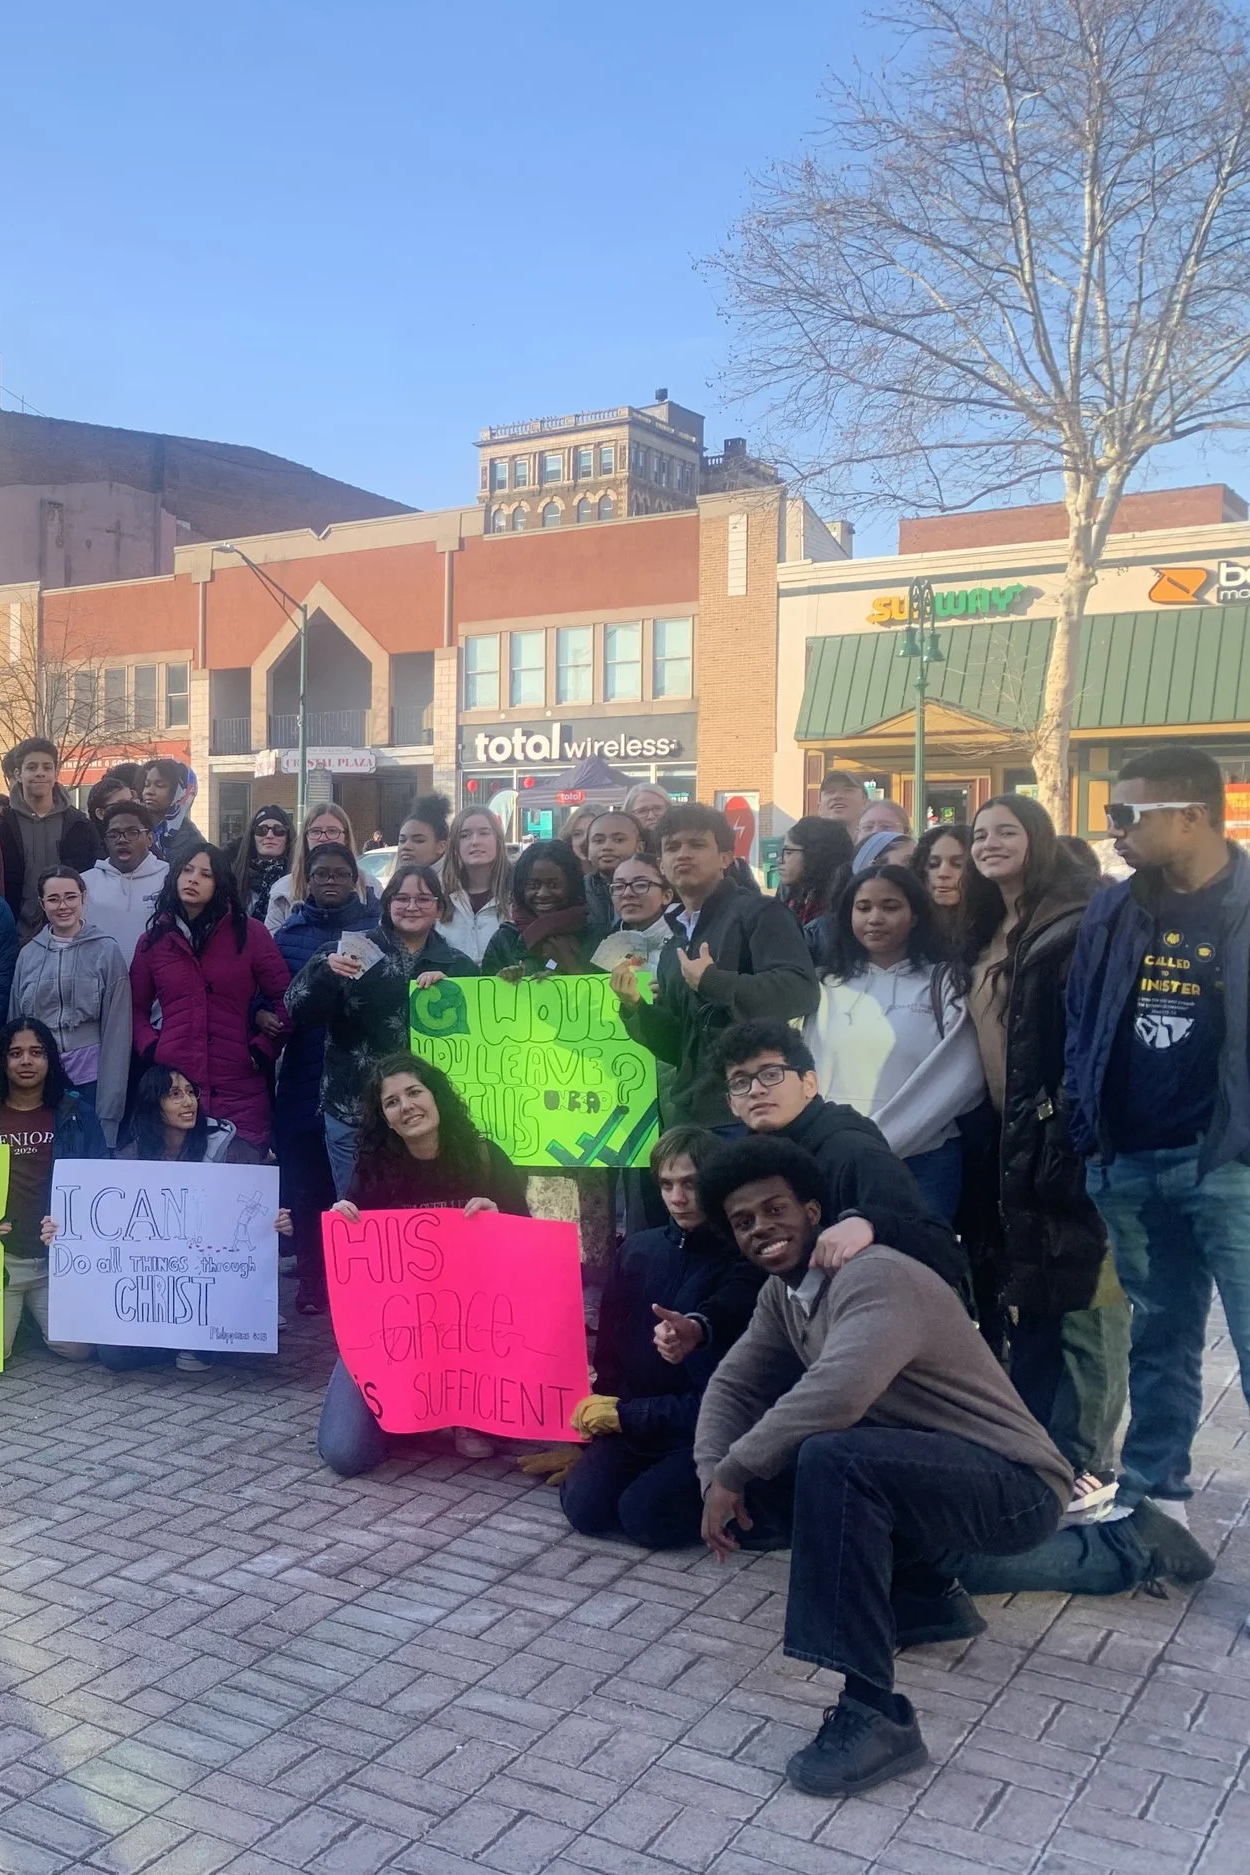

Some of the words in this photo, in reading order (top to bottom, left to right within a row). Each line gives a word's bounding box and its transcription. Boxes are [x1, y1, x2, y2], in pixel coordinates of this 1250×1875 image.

[475, 722, 561, 762] total
[564, 733, 671, 758] wireless
[286, 758, 334, 768] CSTAL
[337, 757, 374, 768] PLAZA
[560, 791, 582, 801] total
[1144, 955, 1190, 969] CALLED
[1140, 978, 1201, 996] INISTER
[476, 1044, 603, 1086] LEAVE
[14, 1147, 38, 1156] 2026
[55, 1185, 82, 1241] I
[89, 1187, 189, 1241] CAN
[53, 1244, 91, 1277] Do
[96, 1246, 122, 1274] all
[129, 1255, 189, 1273] THINGS
[201, 1255, 256, 1279] through
[331, 1212, 444, 1285] HIS
[114, 1275, 215, 1326] CHRIST
[413, 1368, 574, 1429] SUFFICIENT
